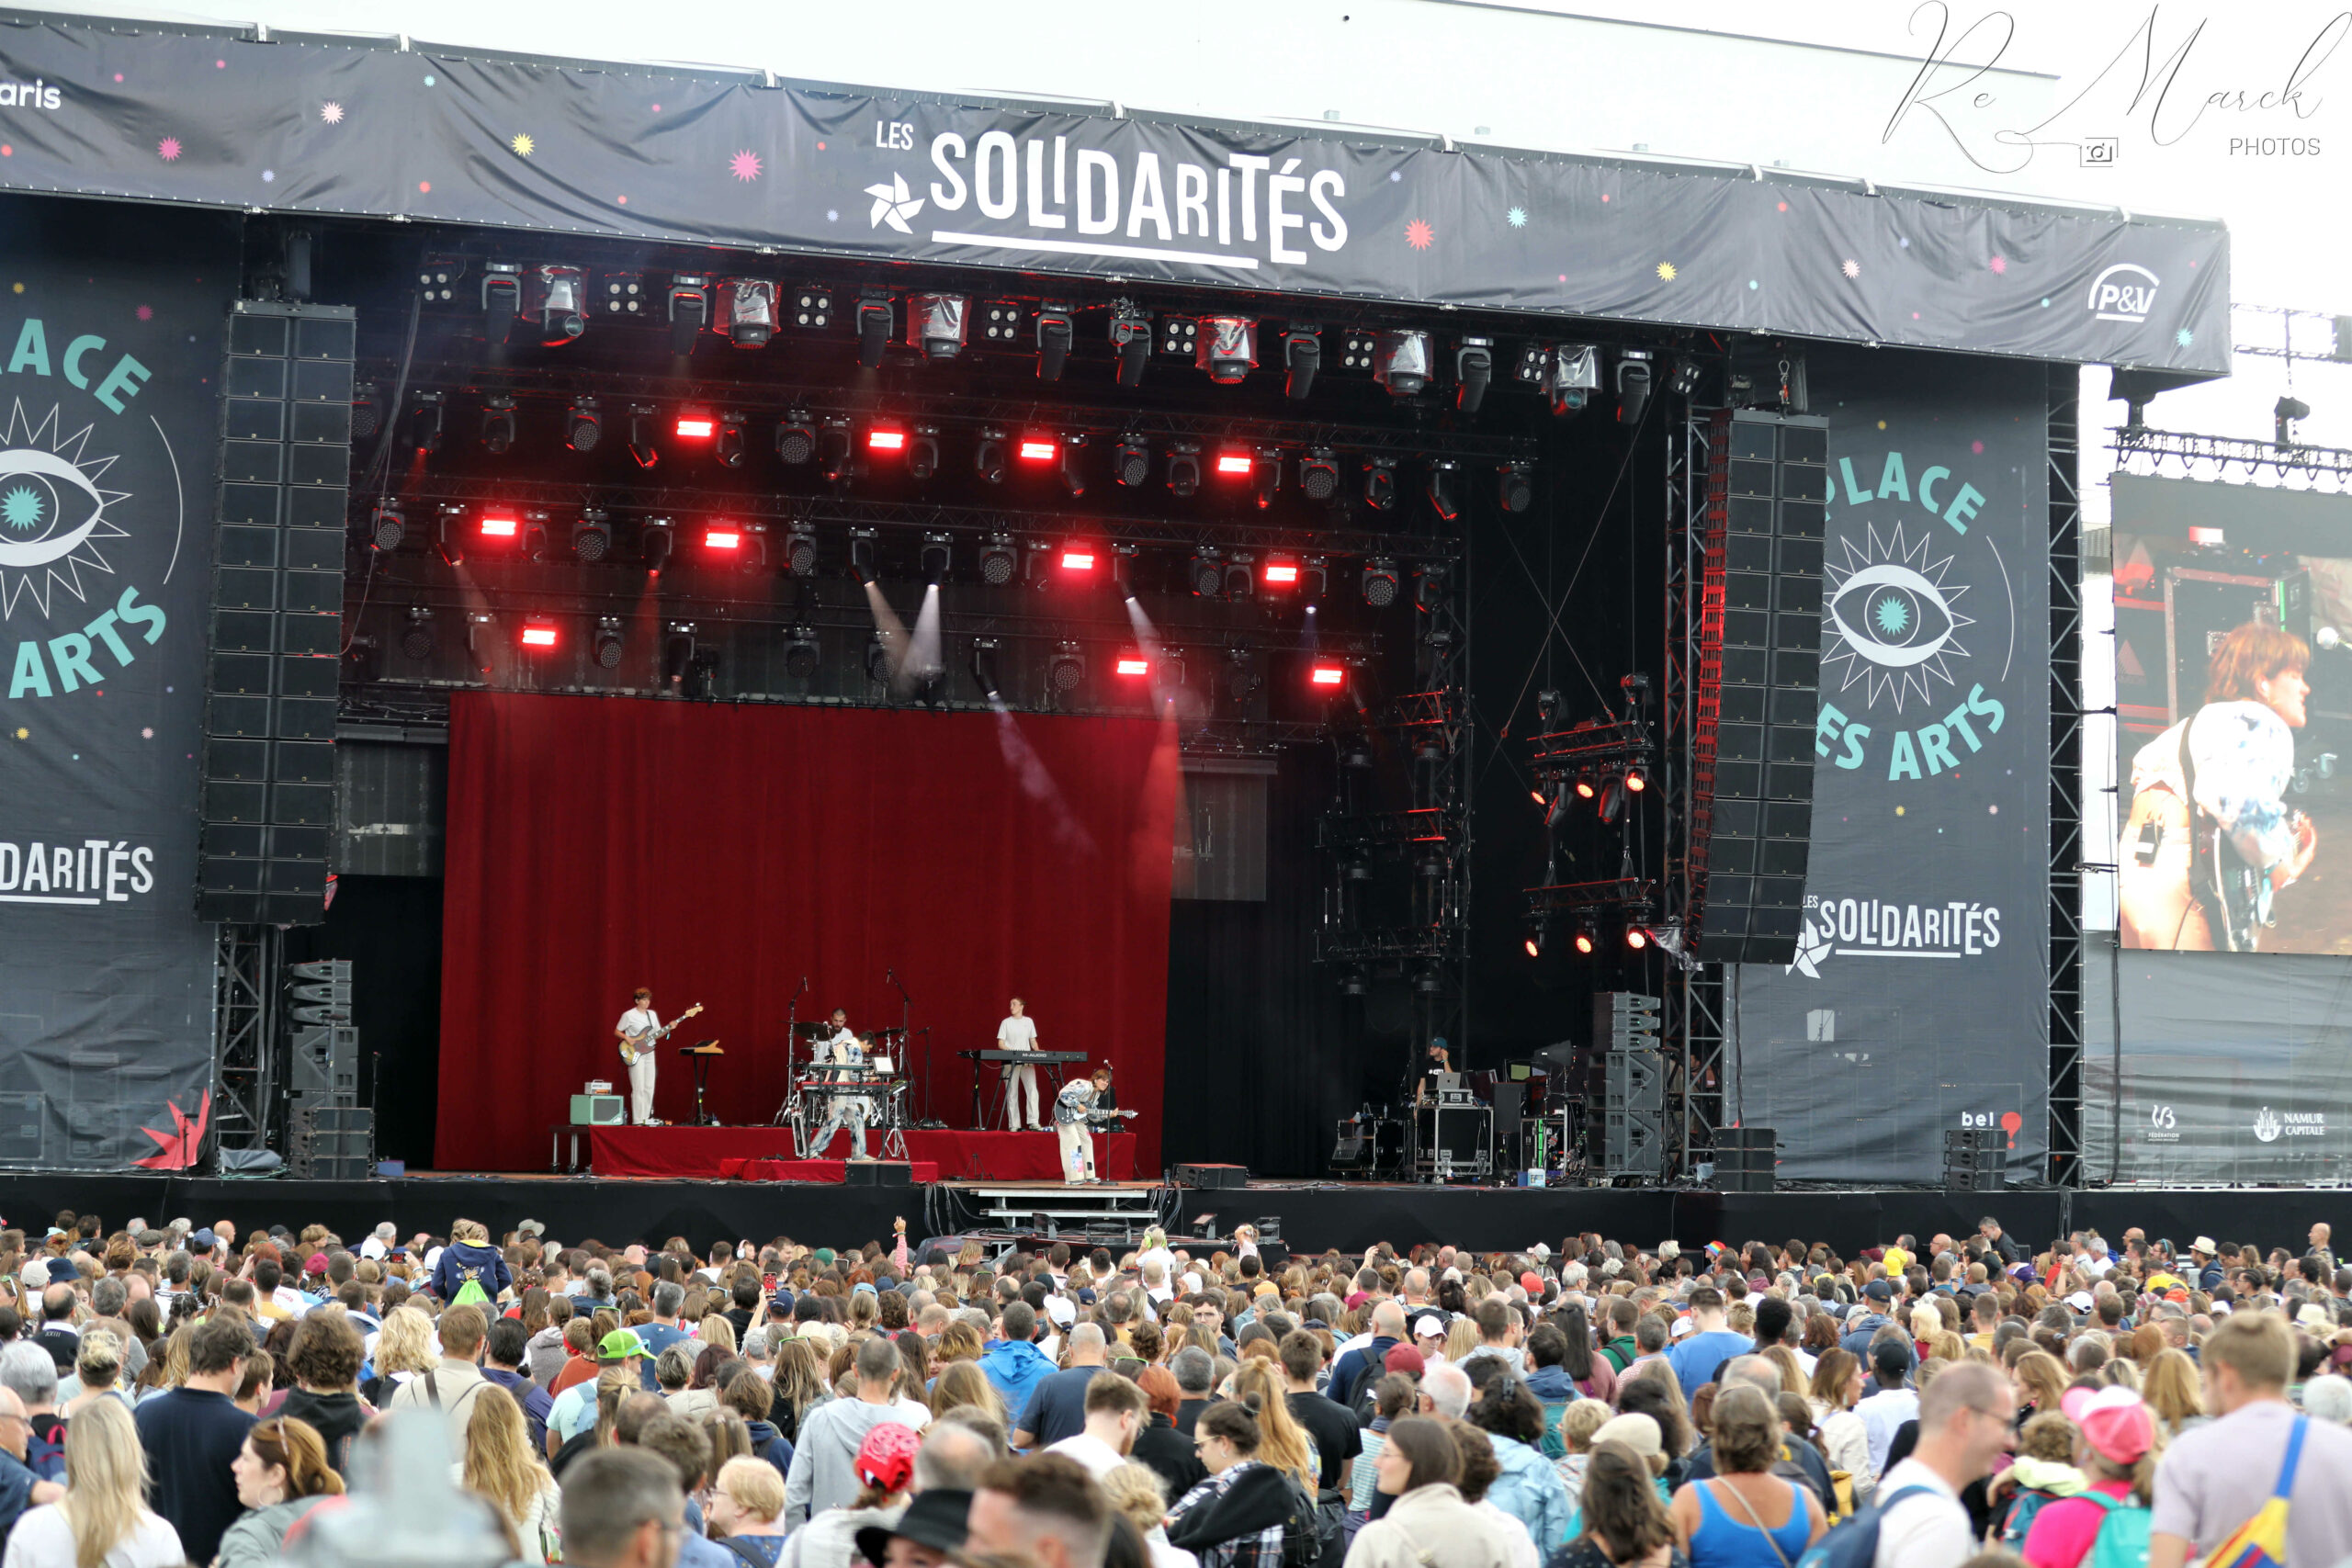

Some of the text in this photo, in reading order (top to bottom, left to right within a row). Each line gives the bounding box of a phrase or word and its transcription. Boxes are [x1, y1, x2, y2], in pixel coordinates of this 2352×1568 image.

[876, 120, 914, 151] LES
[930, 130, 1349, 265] SOLIDARITÉS
[2098, 284, 2157, 314] P&V
[0, 318, 153, 415] ACE
[8, 585, 166, 699] ARTS
[1815, 682, 2005, 781] ES ARTS
[1819, 898, 2000, 954] SOLIDARITÉS
[1962, 1111, 1994, 1127] bel
[2284, 1112, 2324, 1124] NAMUR
[2285, 1125, 2326, 1135] CAPITALE
